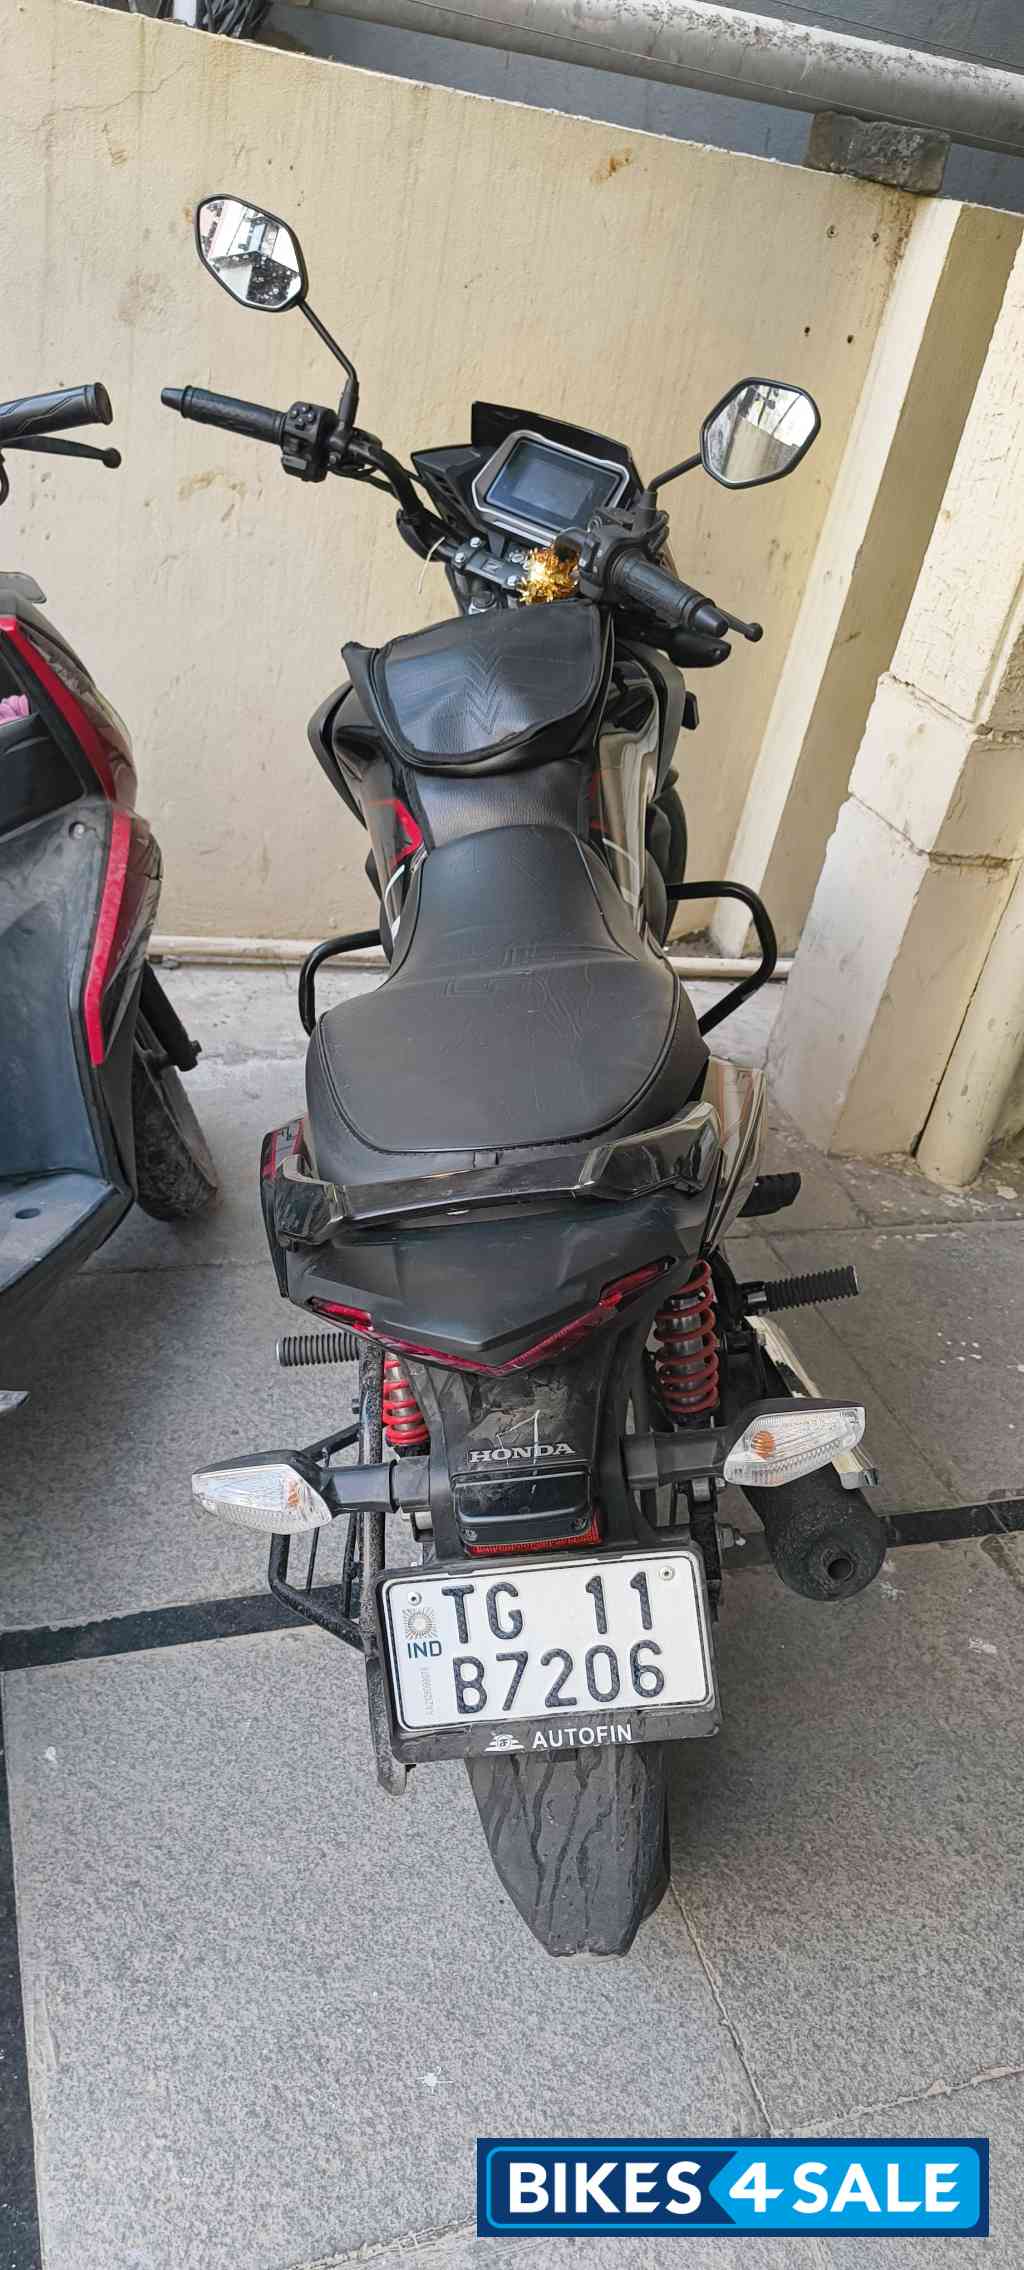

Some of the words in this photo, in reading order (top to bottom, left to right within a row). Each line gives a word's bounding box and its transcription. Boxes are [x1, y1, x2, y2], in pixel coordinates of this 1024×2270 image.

[469, 1443, 575, 1463] HONDA
[441, 1581, 523, 1643] TG
[585, 1571, 653, 1634] 11
[407, 1640, 443, 1659] IND
[452, 1639, 665, 1714] B7206
[531, 1723, 633, 1749] AUTOFIN
